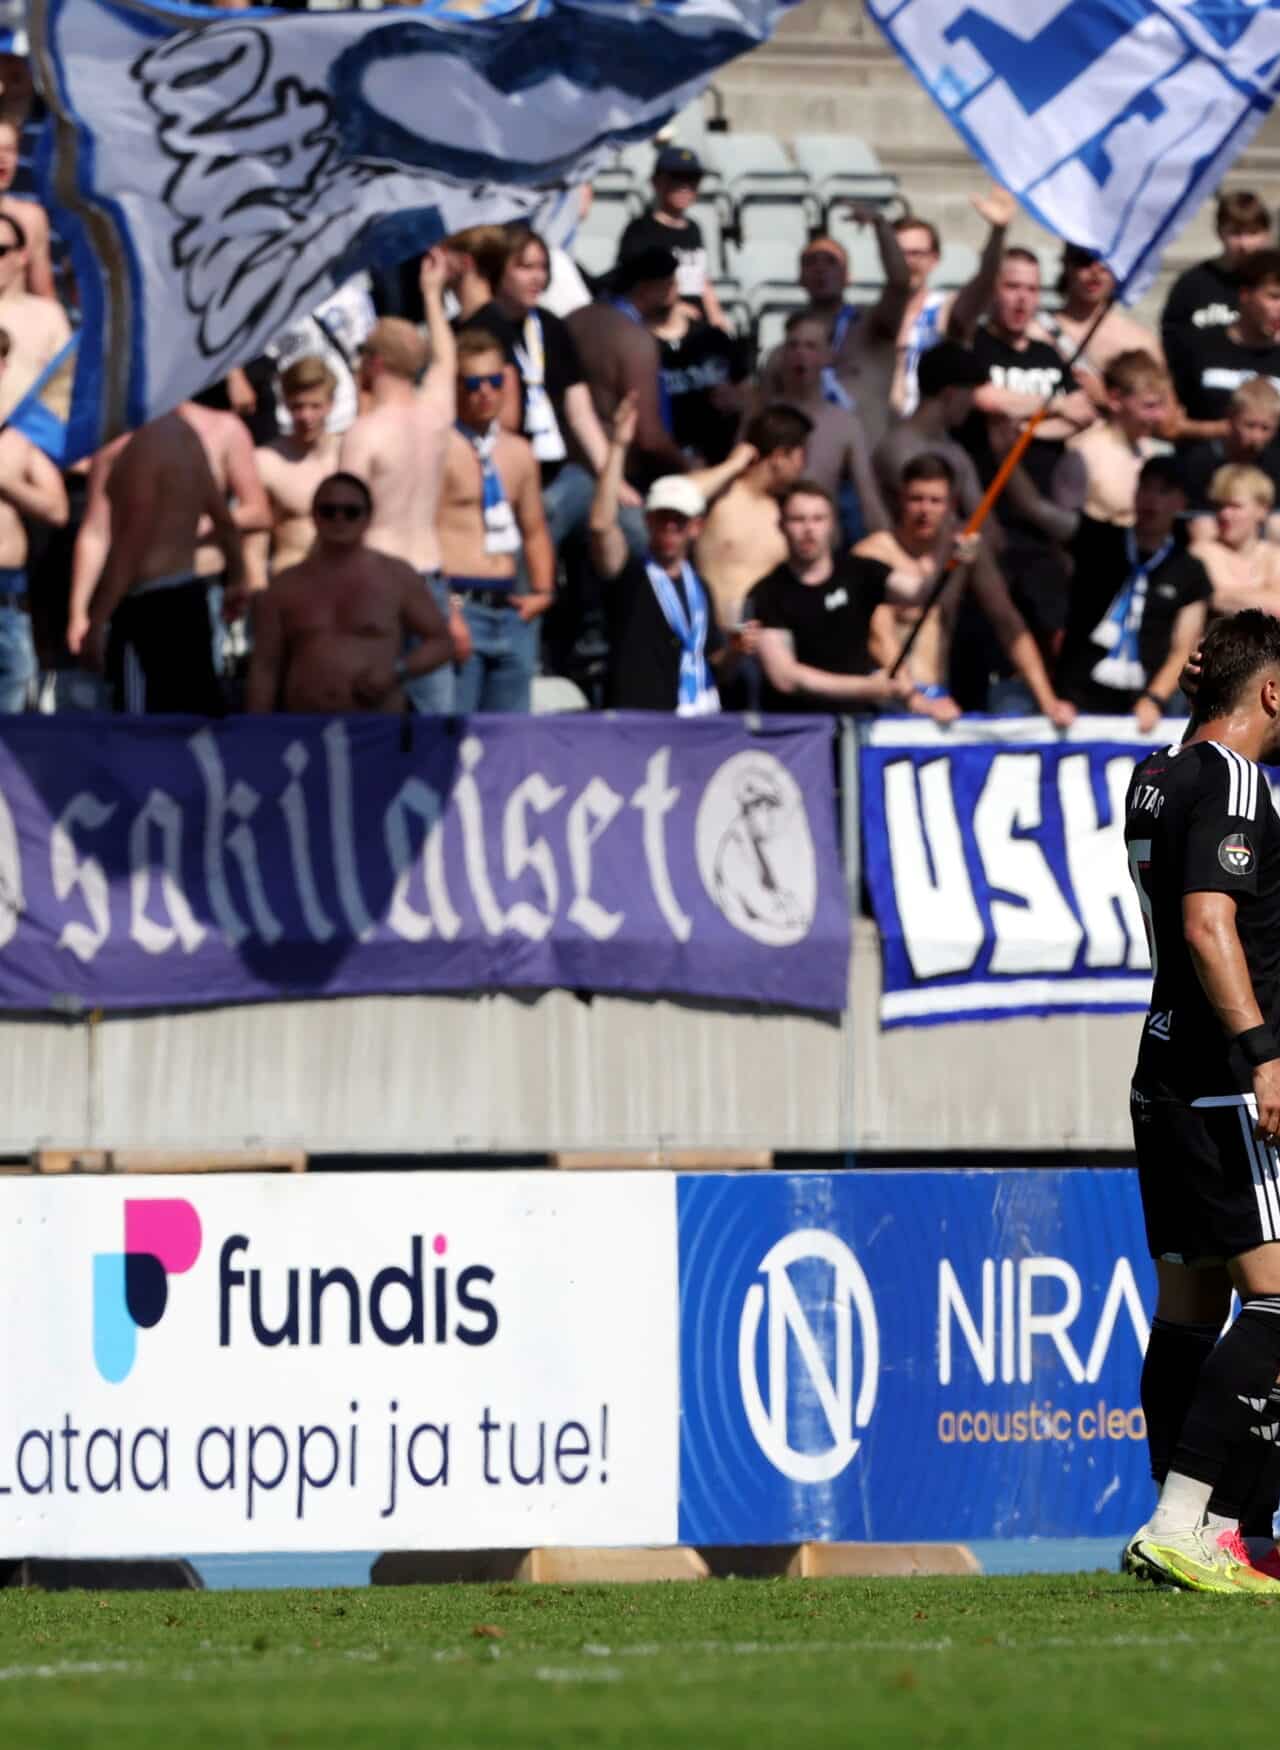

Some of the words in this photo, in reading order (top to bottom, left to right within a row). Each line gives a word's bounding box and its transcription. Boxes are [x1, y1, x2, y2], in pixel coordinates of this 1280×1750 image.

[1131, 785, 1165, 819] NTAS
[883, 752, 1154, 979] USH
[218, 1233, 500, 1348] fundis
[196, 1400, 359, 1520] appi
[380, 1400, 449, 1518] ja
[479, 1403, 610, 1486] tue!
[938, 1402, 1071, 1444] acoustic
[1077, 1399, 1147, 1441] clea
